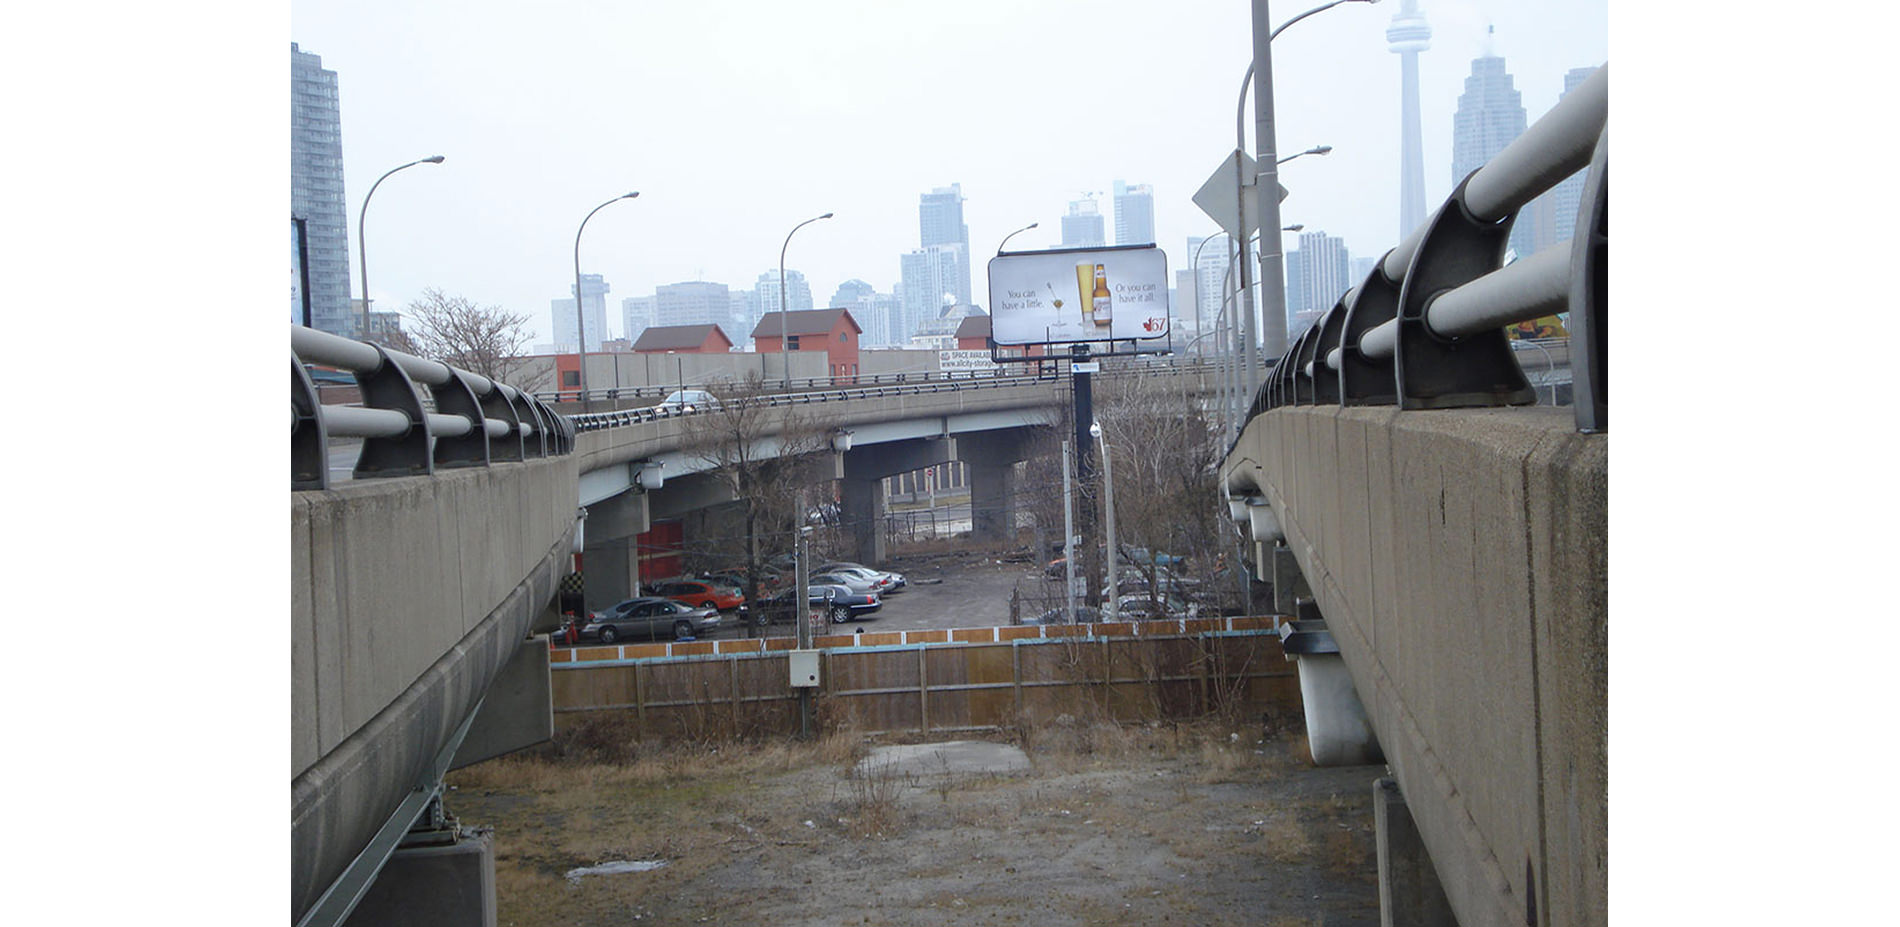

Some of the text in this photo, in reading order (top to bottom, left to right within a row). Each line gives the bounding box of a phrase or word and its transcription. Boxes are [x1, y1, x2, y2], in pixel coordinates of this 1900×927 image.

[1115, 283, 1156, 294] Or you can
[1007, 290, 1036, 298] You can
[1118, 293, 1136, 303] have
[1001, 300, 1019, 310] have
[1151, 317, 1166, 331] 67
[952, 351, 968, 359] SPACE
